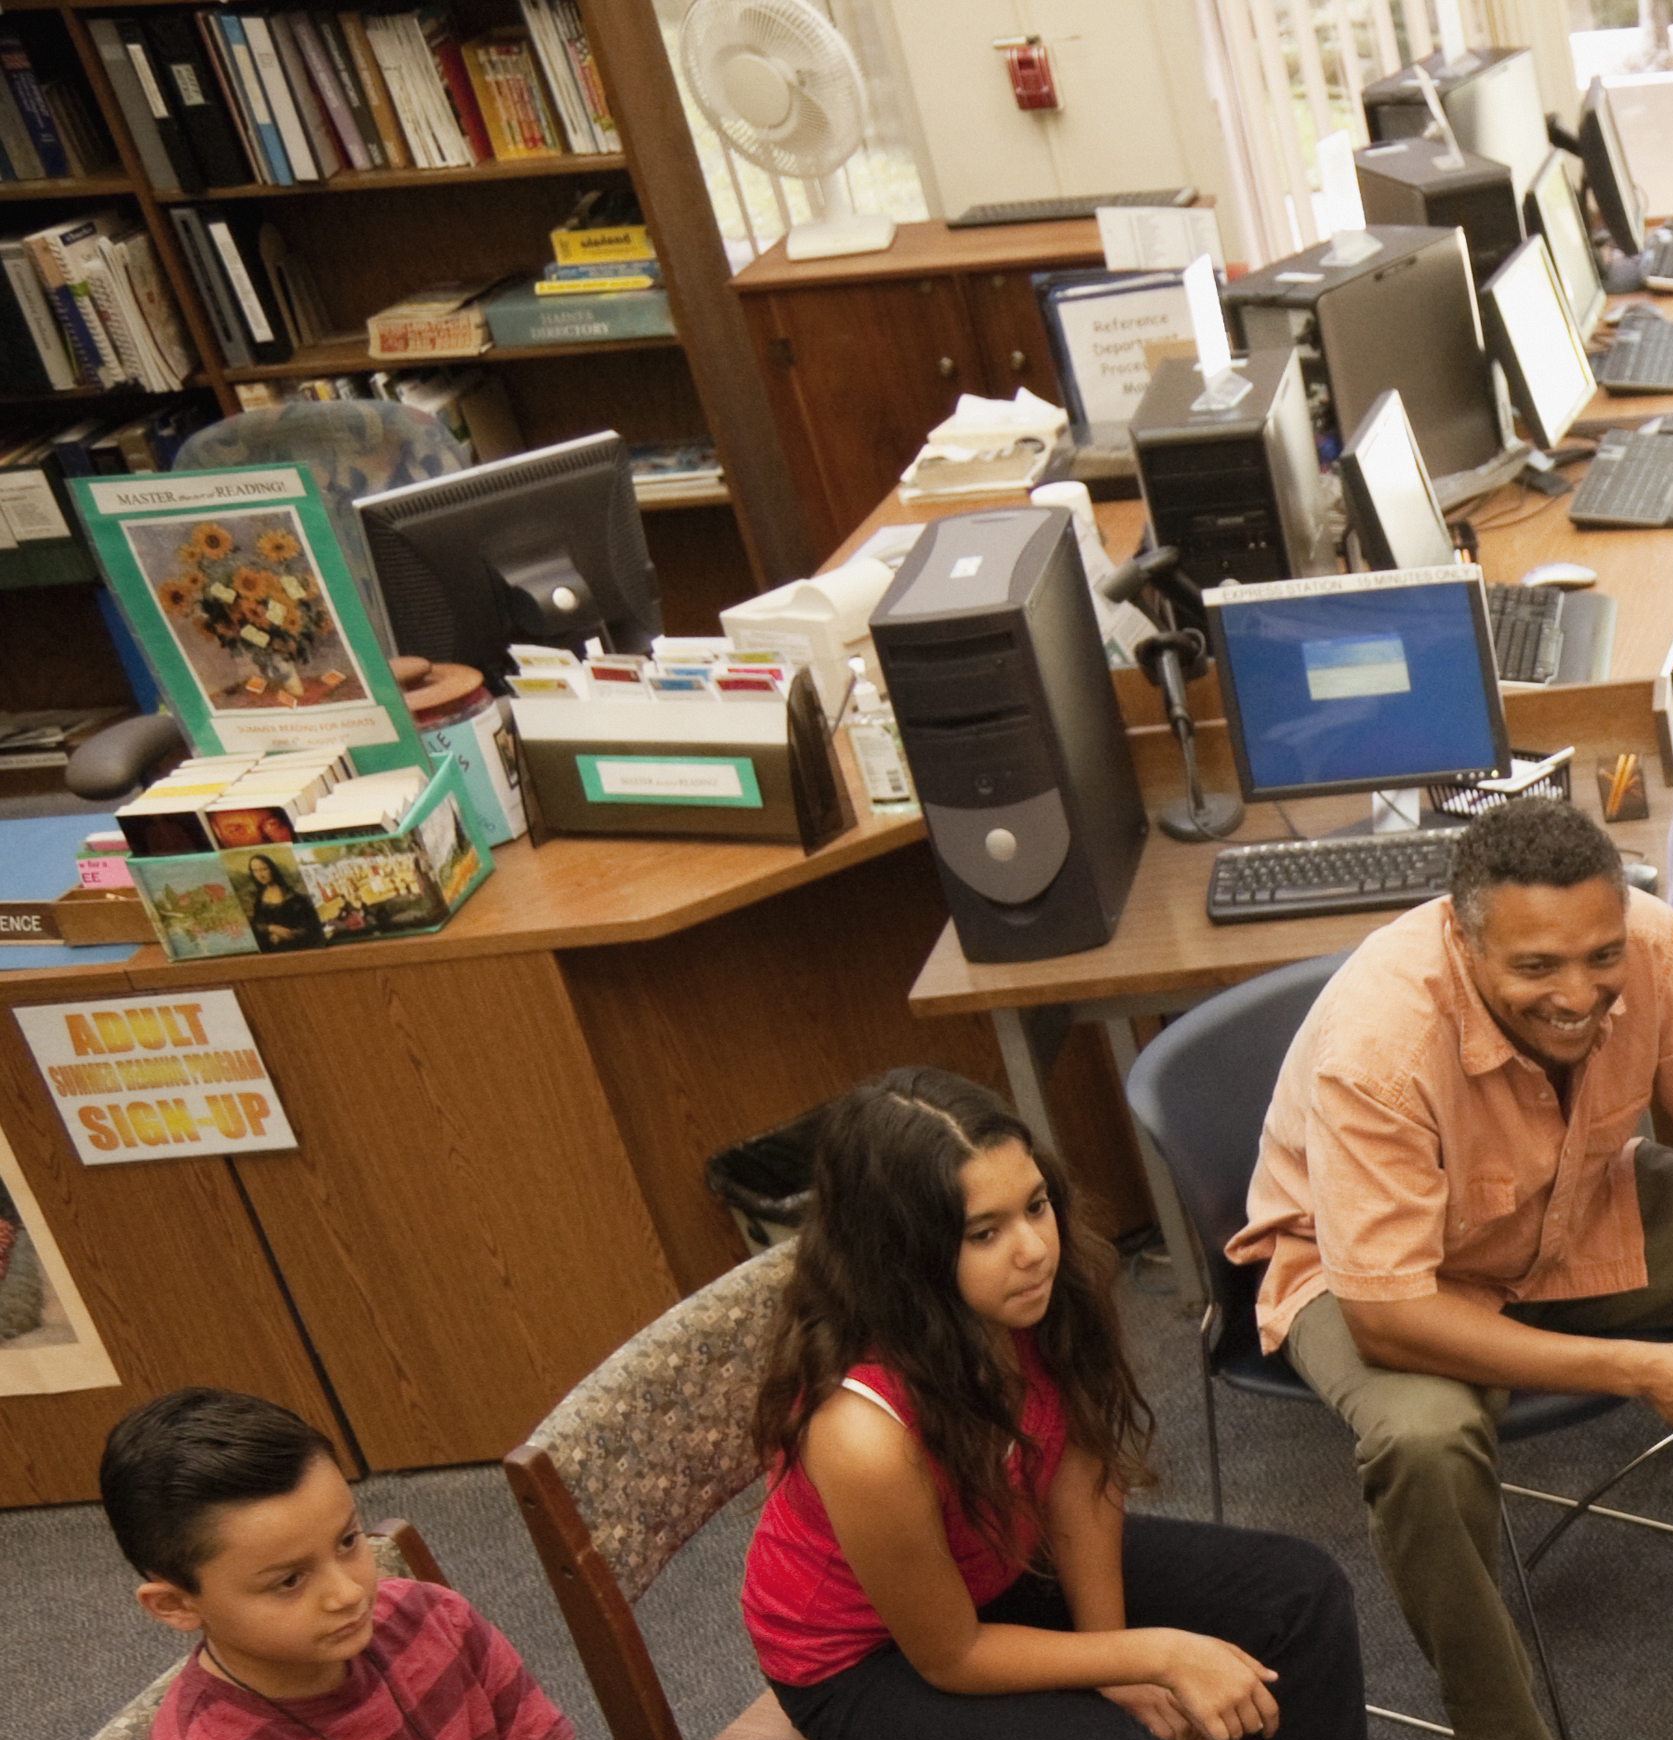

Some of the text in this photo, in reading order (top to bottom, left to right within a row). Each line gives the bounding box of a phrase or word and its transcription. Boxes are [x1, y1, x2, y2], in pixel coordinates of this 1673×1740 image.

[531, 321, 610, 340] DIRECTORY
[1092, 313, 1169, 333] Reference
[117, 491, 176, 507] MASTER
[214, 481, 287, 498] READING!
[1222, 584, 1286, 601] EXPRESS
[1286, 579, 1343, 595] STATION
[1374, 571, 1432, 588] MINUTES
[1434, 567, 1471, 581] ONLY
[0, 915, 43, 932] ENCE
[65, 1003, 210, 1057] ADULT
[48, 1049, 266, 1098] SUMMER READING PROGRAM
[78, 1092, 272, 1151] SIGN-UP
